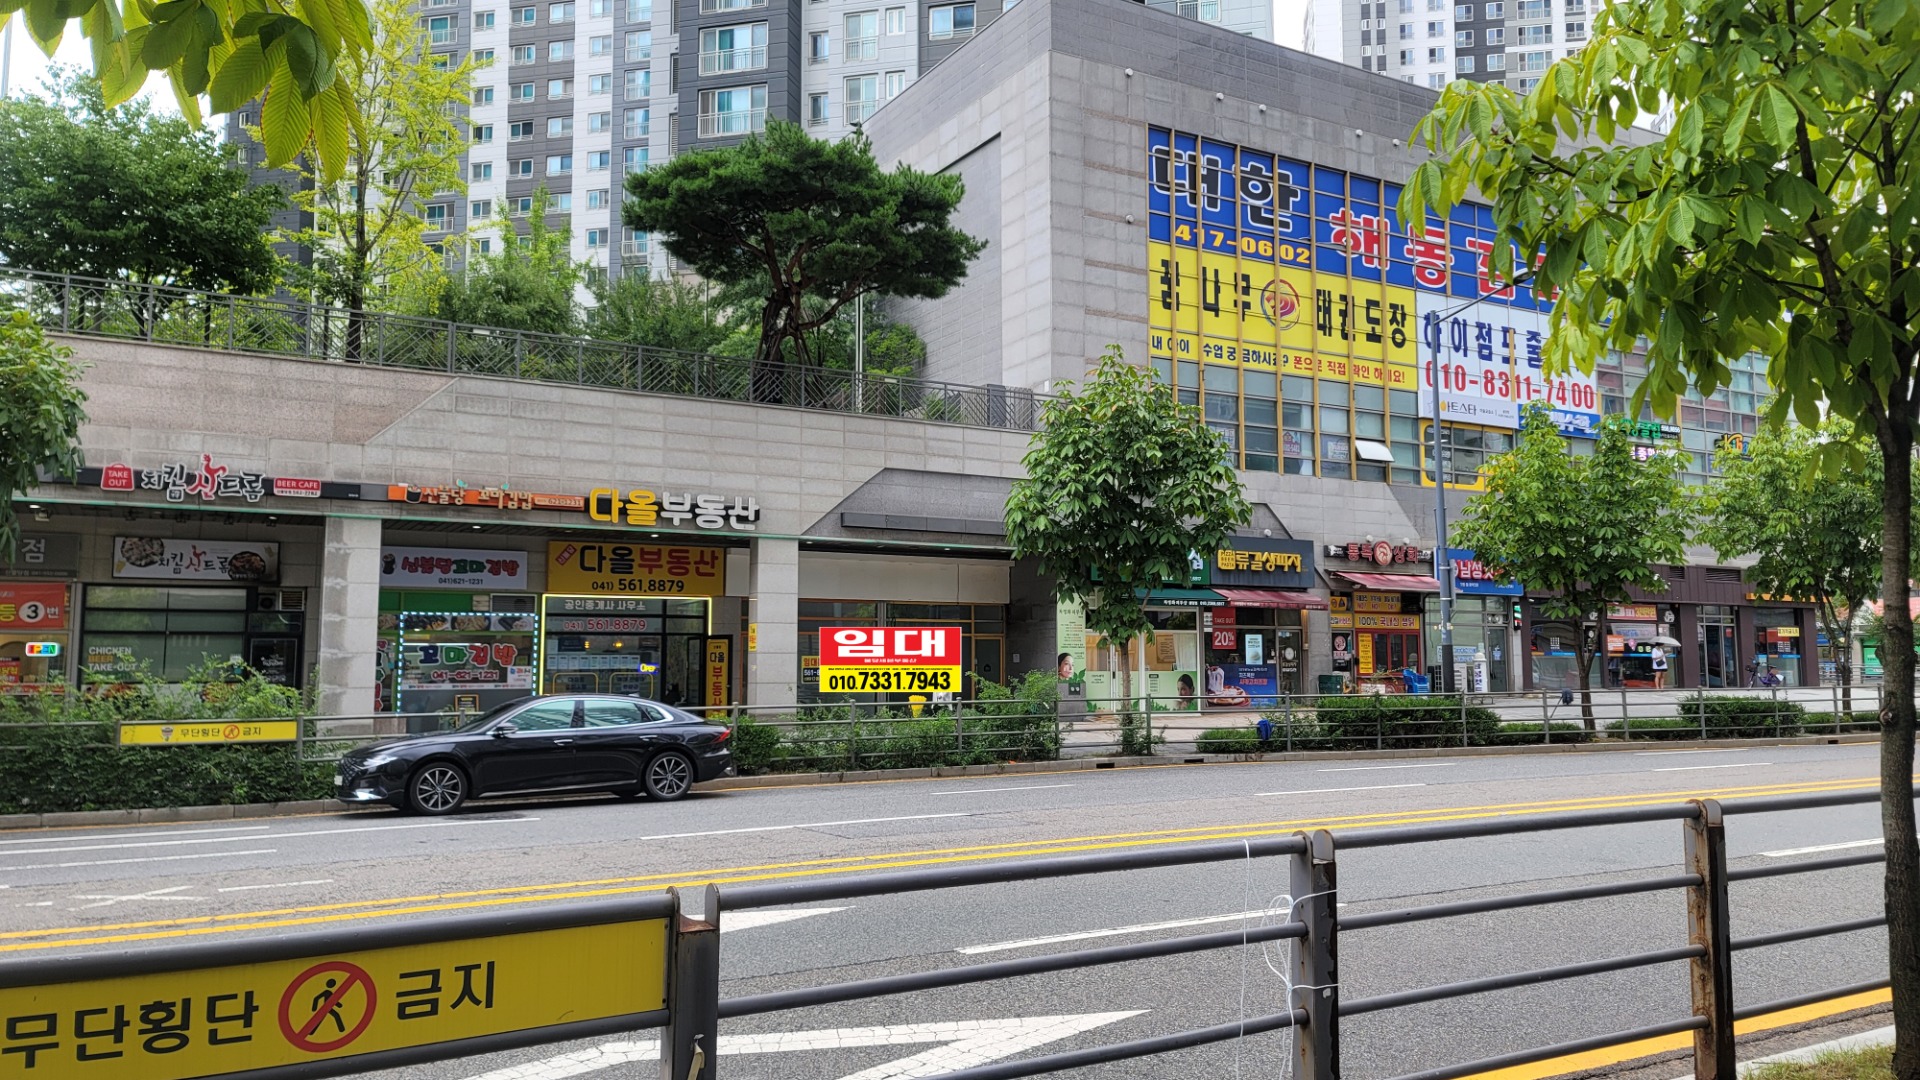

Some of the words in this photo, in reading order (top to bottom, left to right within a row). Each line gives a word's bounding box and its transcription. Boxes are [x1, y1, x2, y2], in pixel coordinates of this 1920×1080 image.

[1152, 145, 1300, 232] 대한
[1175, 224, 1310, 264] 417-0602
[1316, 289, 1407, 348] 태권도장
[1152, 335, 1162, 351] 내
[1203, 342, 1223, 359] 수업
[1327, 360, 1346, 376] 직접
[107, 470, 129, 478] TAKE
[108, 479, 127, 487] OUT
[298, 481, 318, 489] CAFE
[589, 487, 760, 531] 다올부동산
[579, 545, 719, 578] 다올부동산
[592, 580, 614, 591] 041)
[617, 578, 685, 594] 561.8879
[587, 618, 647, 631] 561.8879
[1358, 617, 1378, 626] 100%
[88, 646, 132, 655] CHICKEN
[180, 728, 220, 738] 무단횡단
[242, 726, 262, 736] 금지
[2, 990, 260, 1069] 무단횡단
[395, 960, 497, 1022] 금지
